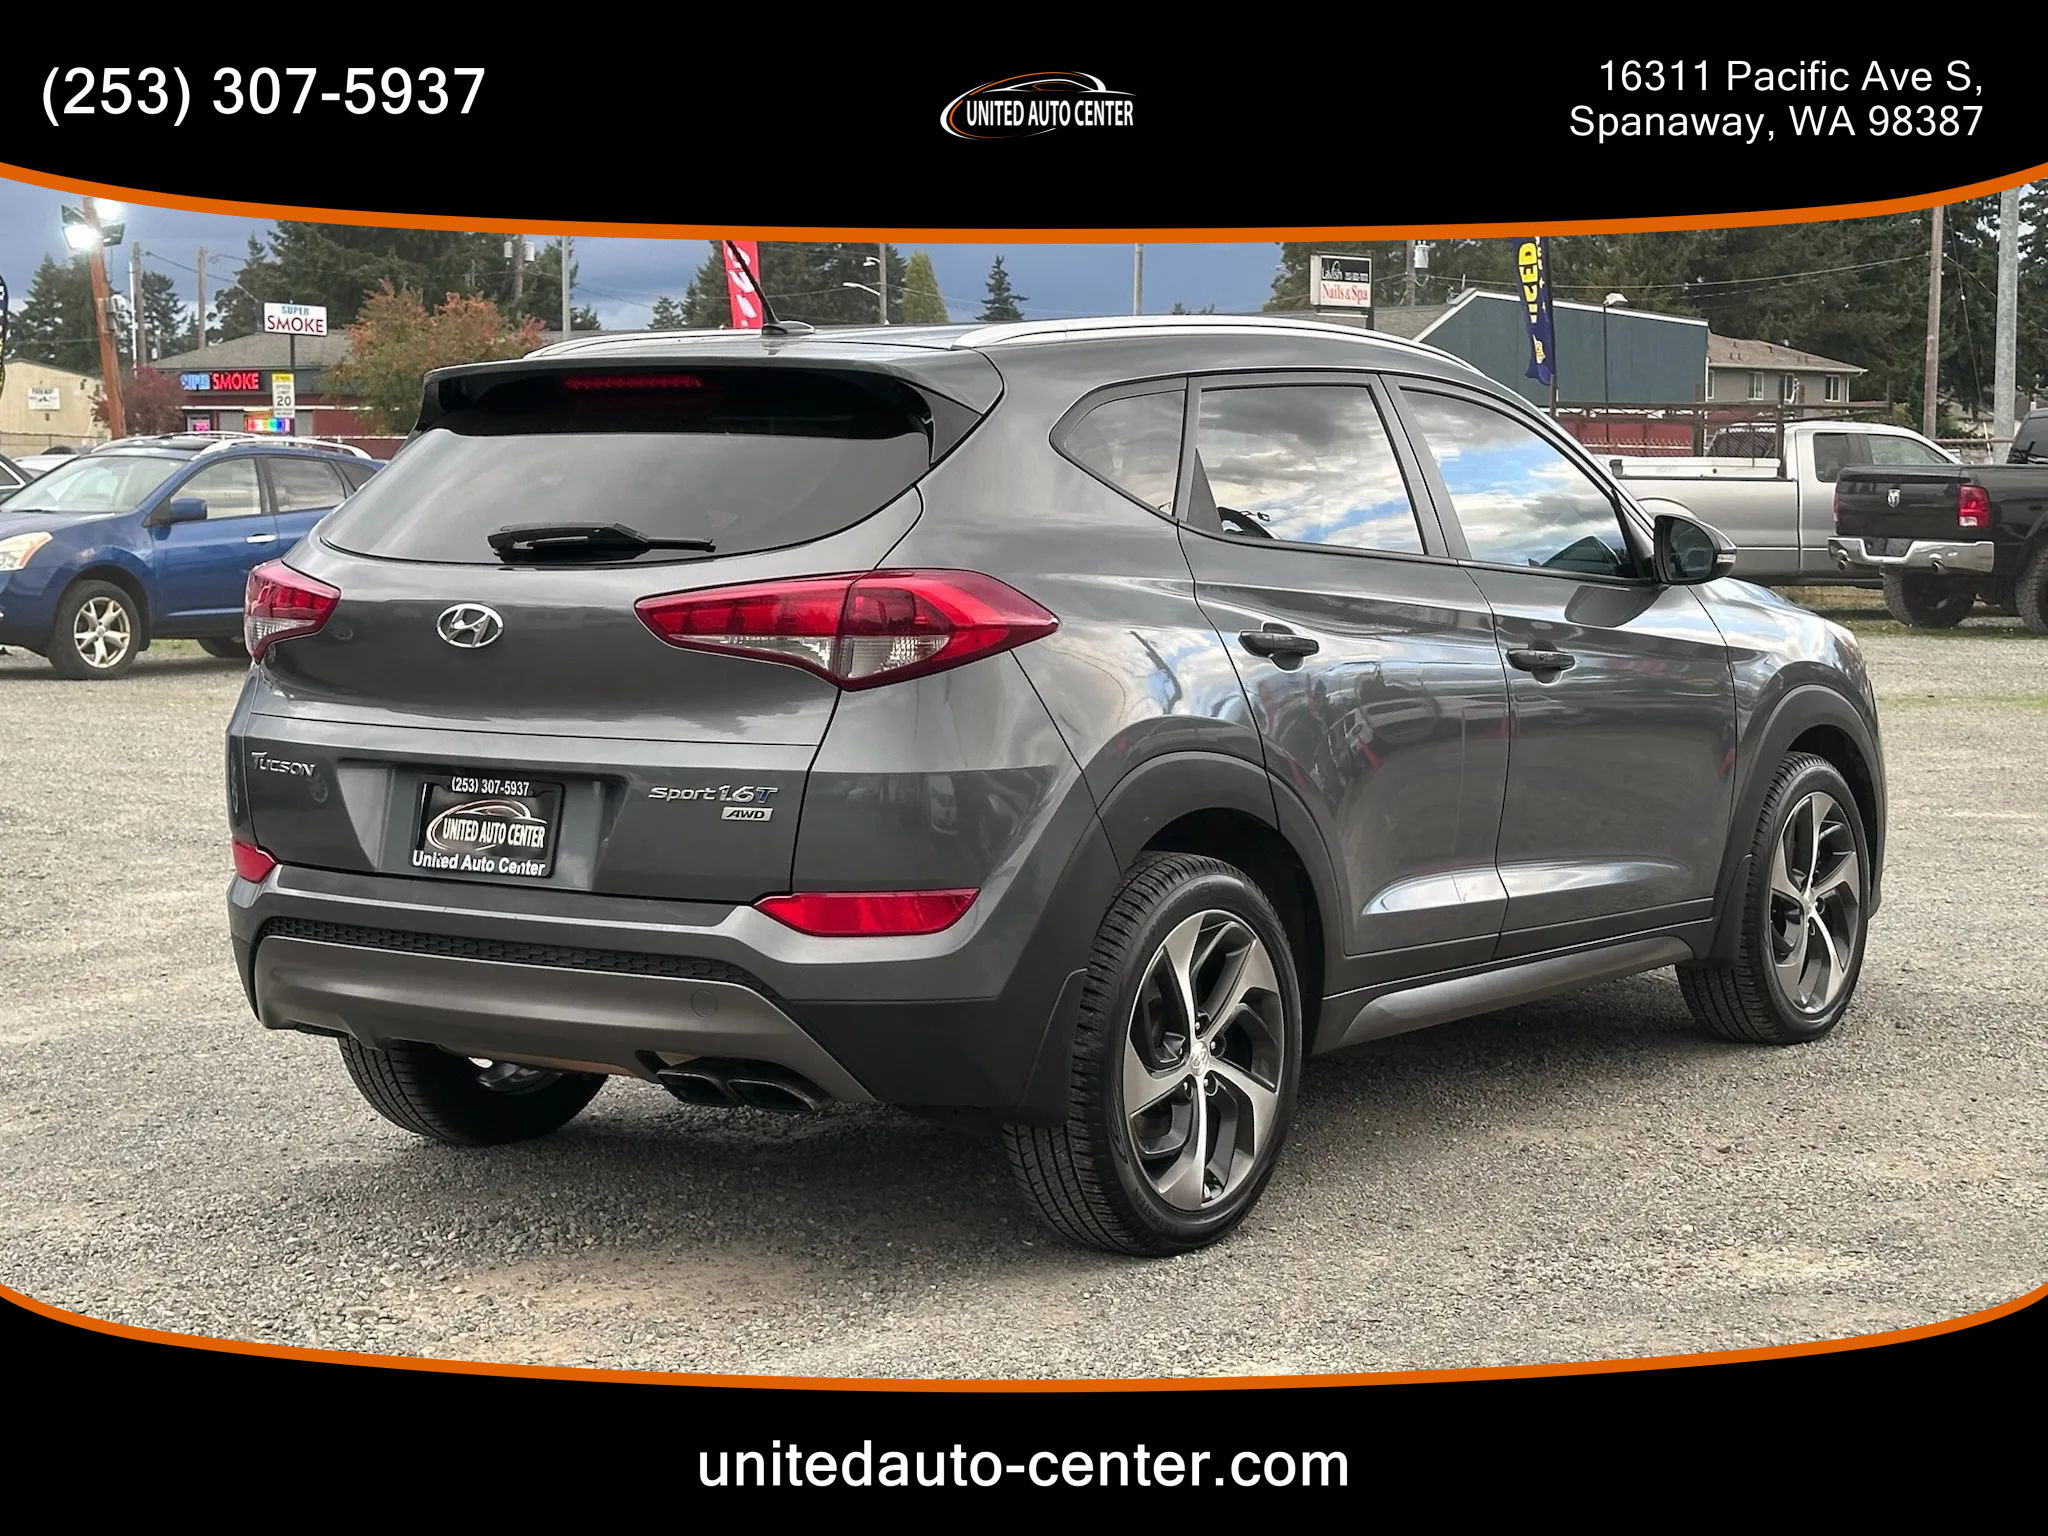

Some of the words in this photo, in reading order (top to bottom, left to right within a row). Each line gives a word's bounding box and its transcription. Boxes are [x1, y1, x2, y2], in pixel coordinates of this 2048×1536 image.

[1322, 283, 1344, 300] Nails
[1351, 285, 1368, 304] Spa
[281, 305, 310, 316] SUPER
[267, 315, 324, 333] SMOKE
[212, 372, 259, 390] SMOKE
[276, 395, 292, 407] 20
[251, 751, 316, 777] TUCSON
[451, 776, 478, 793] (253)
[481, 779, 530, 797] 307-5937
[648, 786, 717, 802] Sport
[726, 809, 765, 820] AWD
[442, 817, 479, 842] UNITED
[478, 820, 507, 845] AUTO
[507, 822, 546, 849] CENTER
[412, 849, 460, 871] United
[460, 853, 495, 873] Auto
[498, 856, 546, 877] Center
